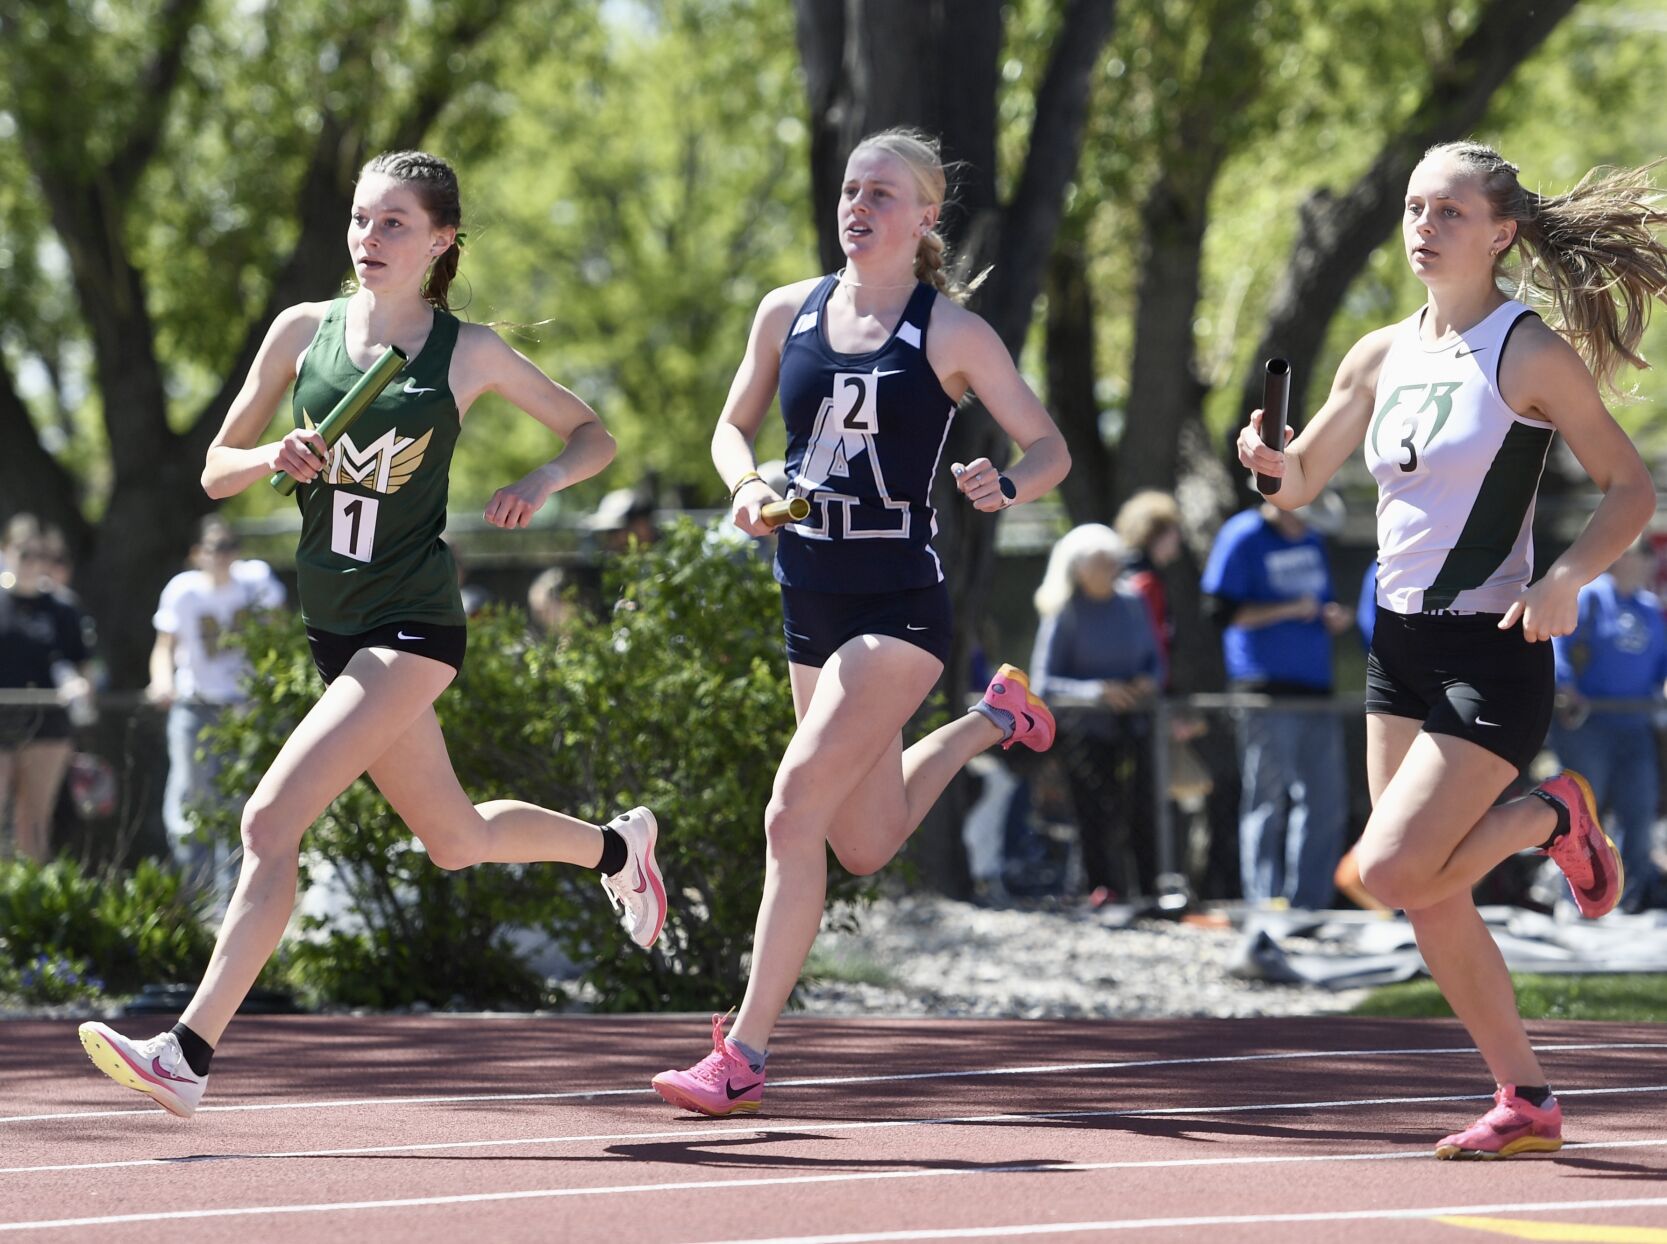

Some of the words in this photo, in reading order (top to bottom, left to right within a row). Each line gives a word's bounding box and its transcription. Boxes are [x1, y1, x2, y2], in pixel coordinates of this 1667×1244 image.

[844, 377, 868, 430] 2
[1399, 417, 1418, 473] 3
[343, 499, 363, 555] 1
